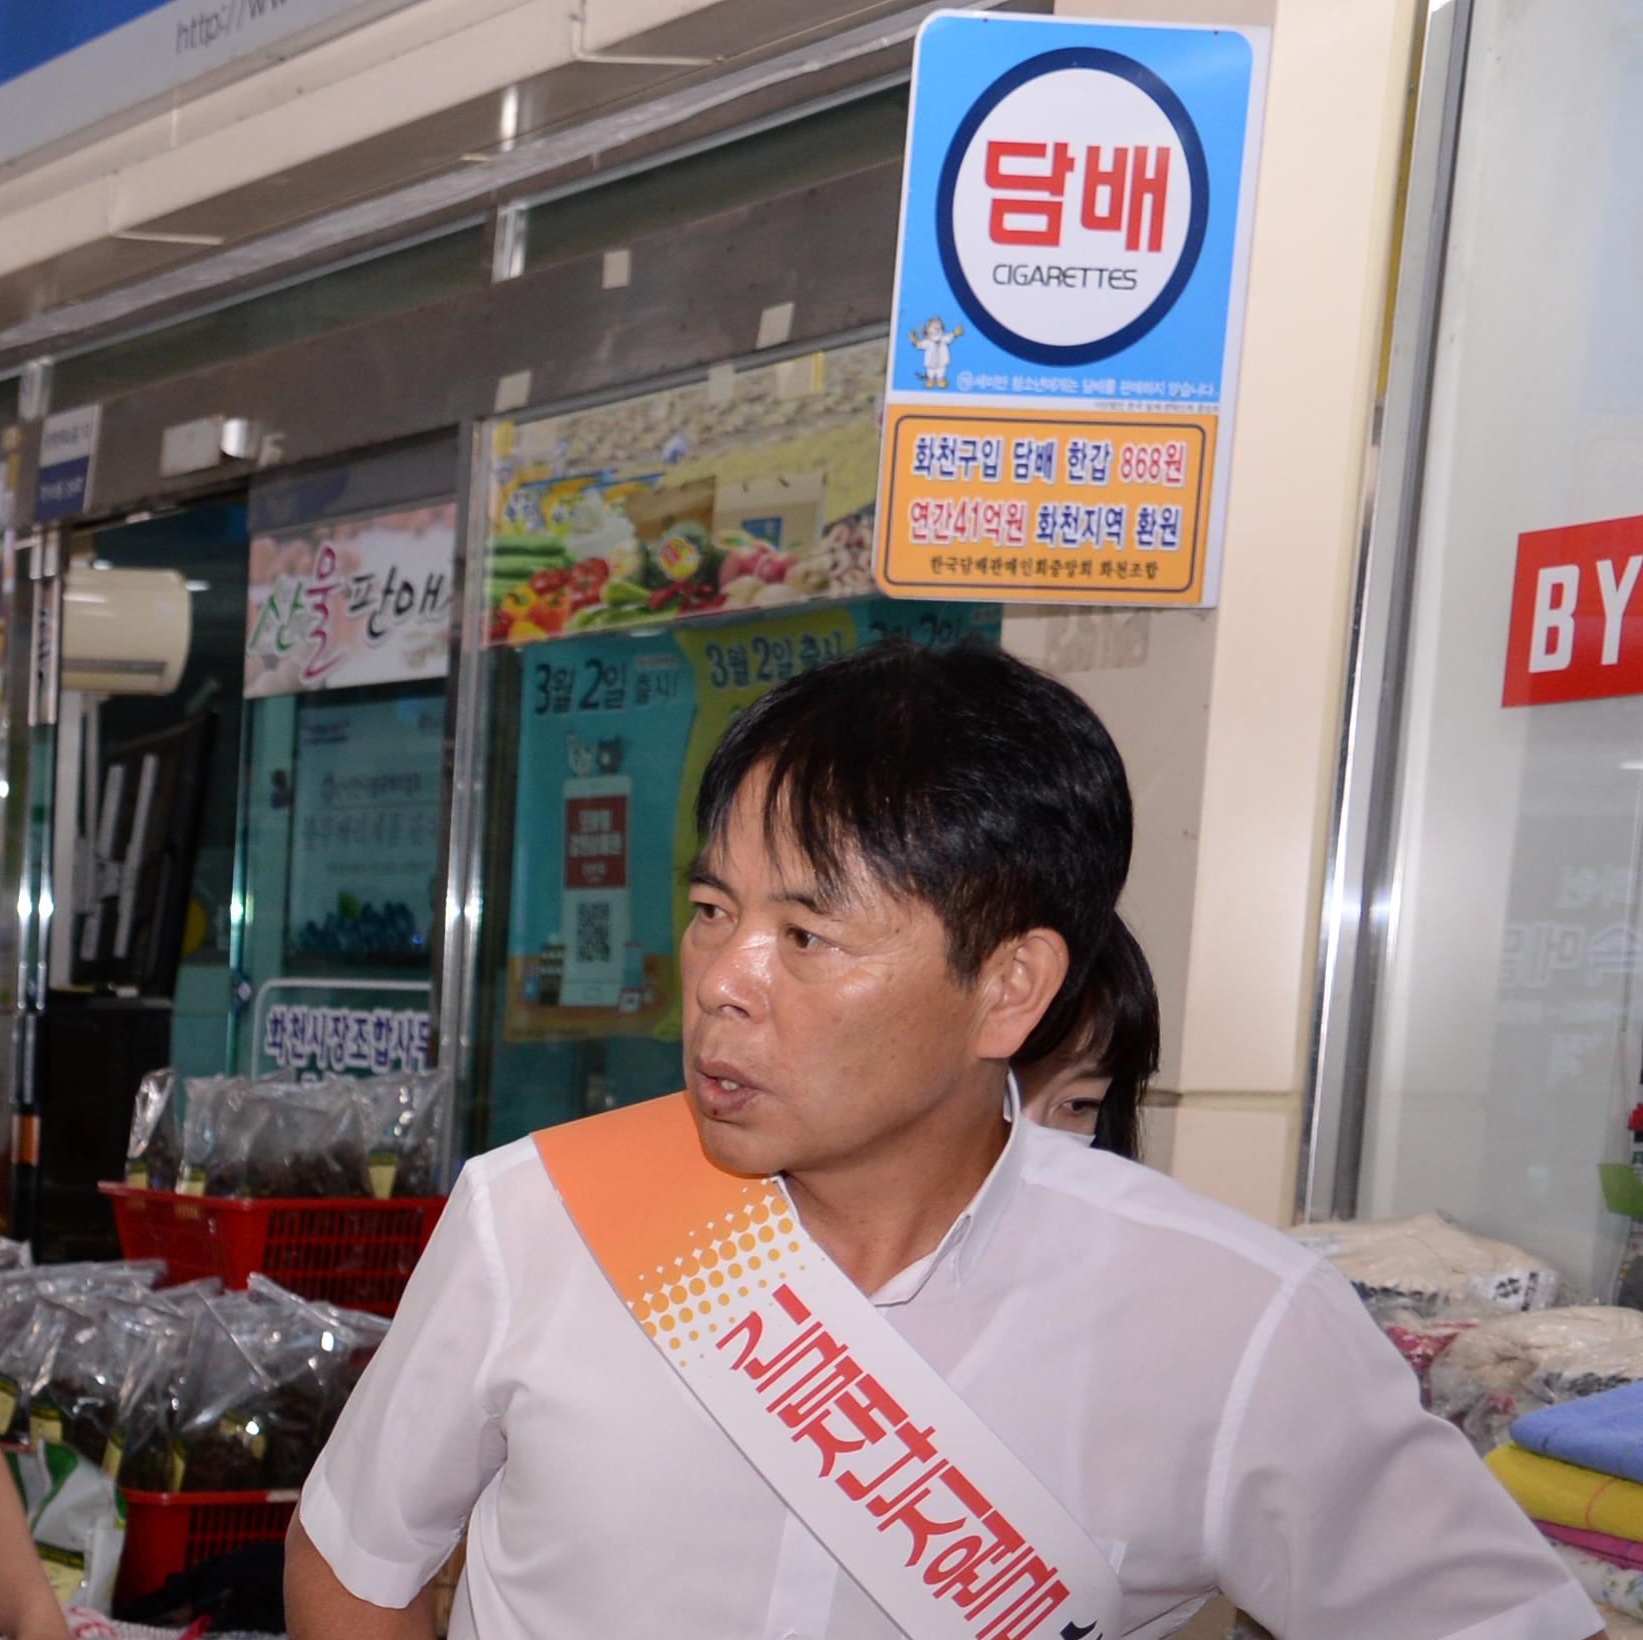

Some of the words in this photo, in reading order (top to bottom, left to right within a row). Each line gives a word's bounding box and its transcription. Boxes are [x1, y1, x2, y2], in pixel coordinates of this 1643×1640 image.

[984, 140, 1171, 253] 담배
[992, 263, 1138, 291] CIGARETTES
[913, 437, 1002, 480] 화천구입
[1013, 440, 1058, 483] 담배
[1067, 441, 1112, 484] 한갑
[1120, 444, 1186, 486] 868원
[909, 500, 1026, 546] 연간41억원
[1035, 504, 1126, 548] 화천지역
[1135, 506, 1181, 550] 환원
[534, 662, 575, 717] 3월
[578, 657, 626, 712] 2일
